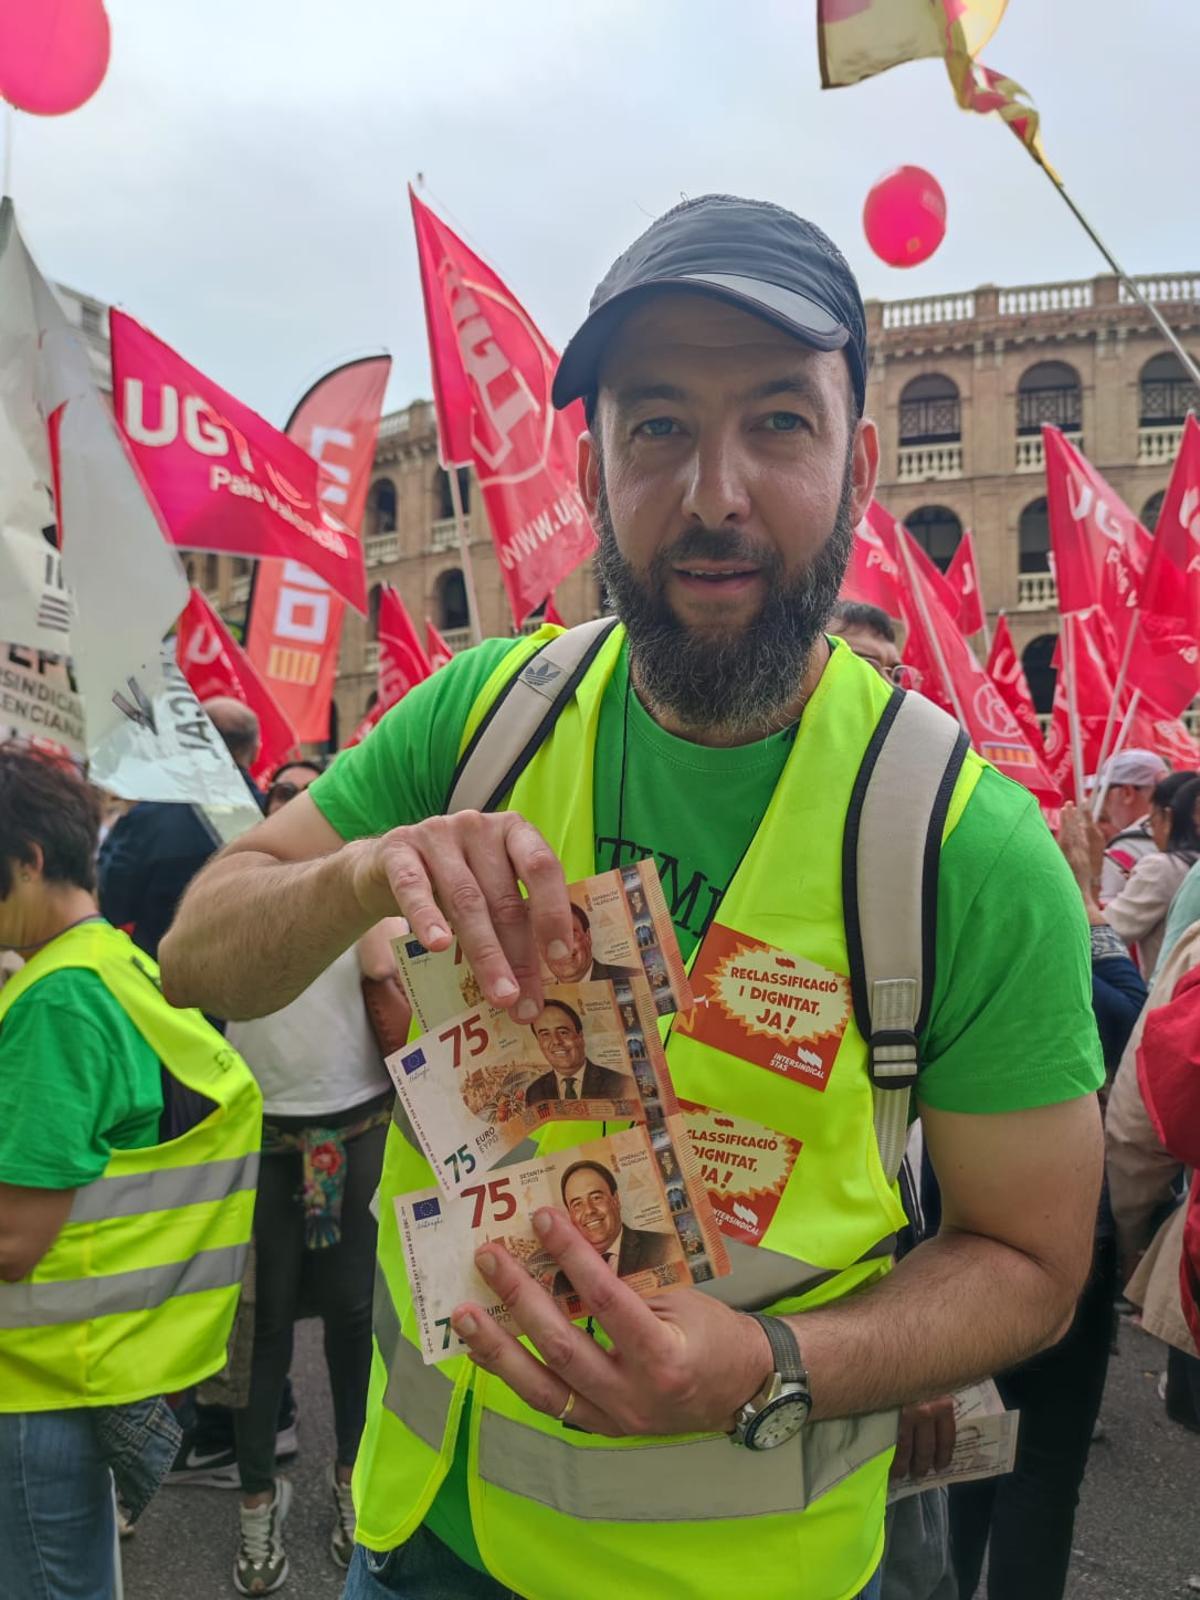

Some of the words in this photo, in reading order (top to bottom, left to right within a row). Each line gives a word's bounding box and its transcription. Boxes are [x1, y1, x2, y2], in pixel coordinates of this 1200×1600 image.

[730, 966, 839, 993] RECLASSIFICACIÓ
[750, 987, 820, 1017] DIGNITAT,
[756, 1008, 797, 1034] JA!
[438, 1013, 489, 1069] 75
[773, 1052, 824, 1080] INTERSINDICAL
[475, 1126, 495, 1146] EURO
[443, 1144, 476, 1184] 75
[460, 1177, 517, 1229] 75
[487, 1303, 509, 1317] URO
